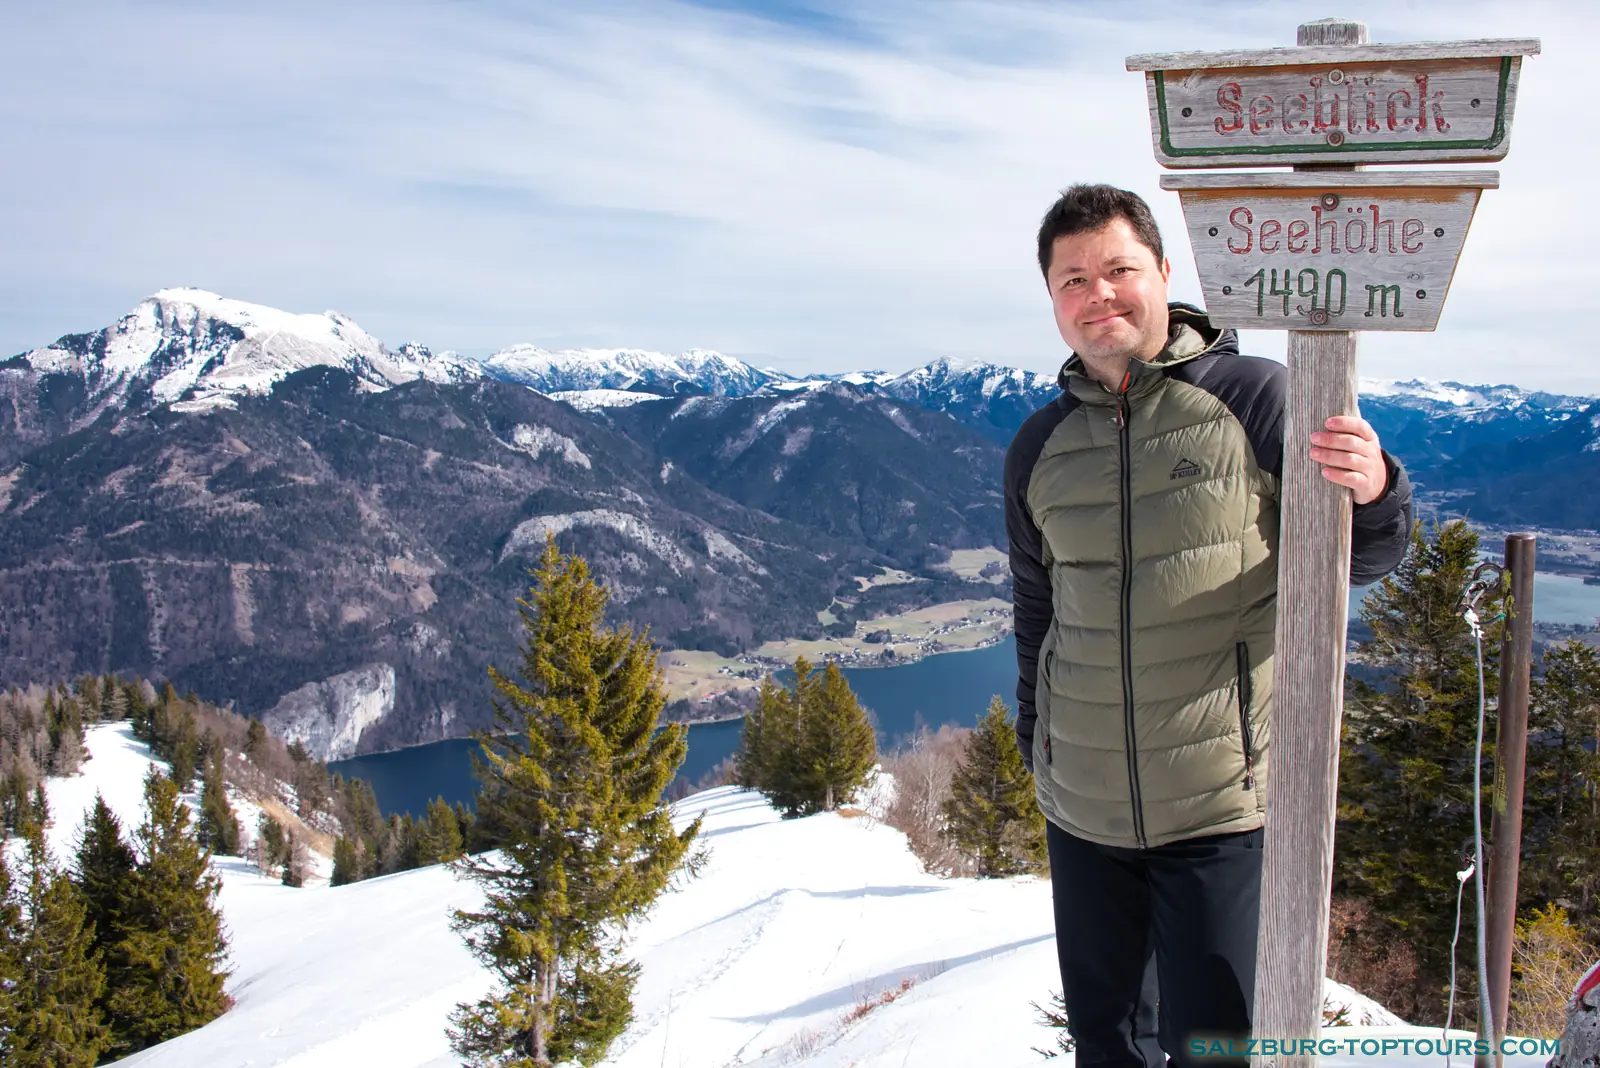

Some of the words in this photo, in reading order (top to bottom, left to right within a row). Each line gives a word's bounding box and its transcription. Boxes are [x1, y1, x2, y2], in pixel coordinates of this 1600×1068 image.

[1214, 73, 1451, 136] Seeblick
[1227, 204, 1424, 254] Seehöhe
[1243, 268, 1348, 318] 1490
[1364, 284, 1404, 318] m
